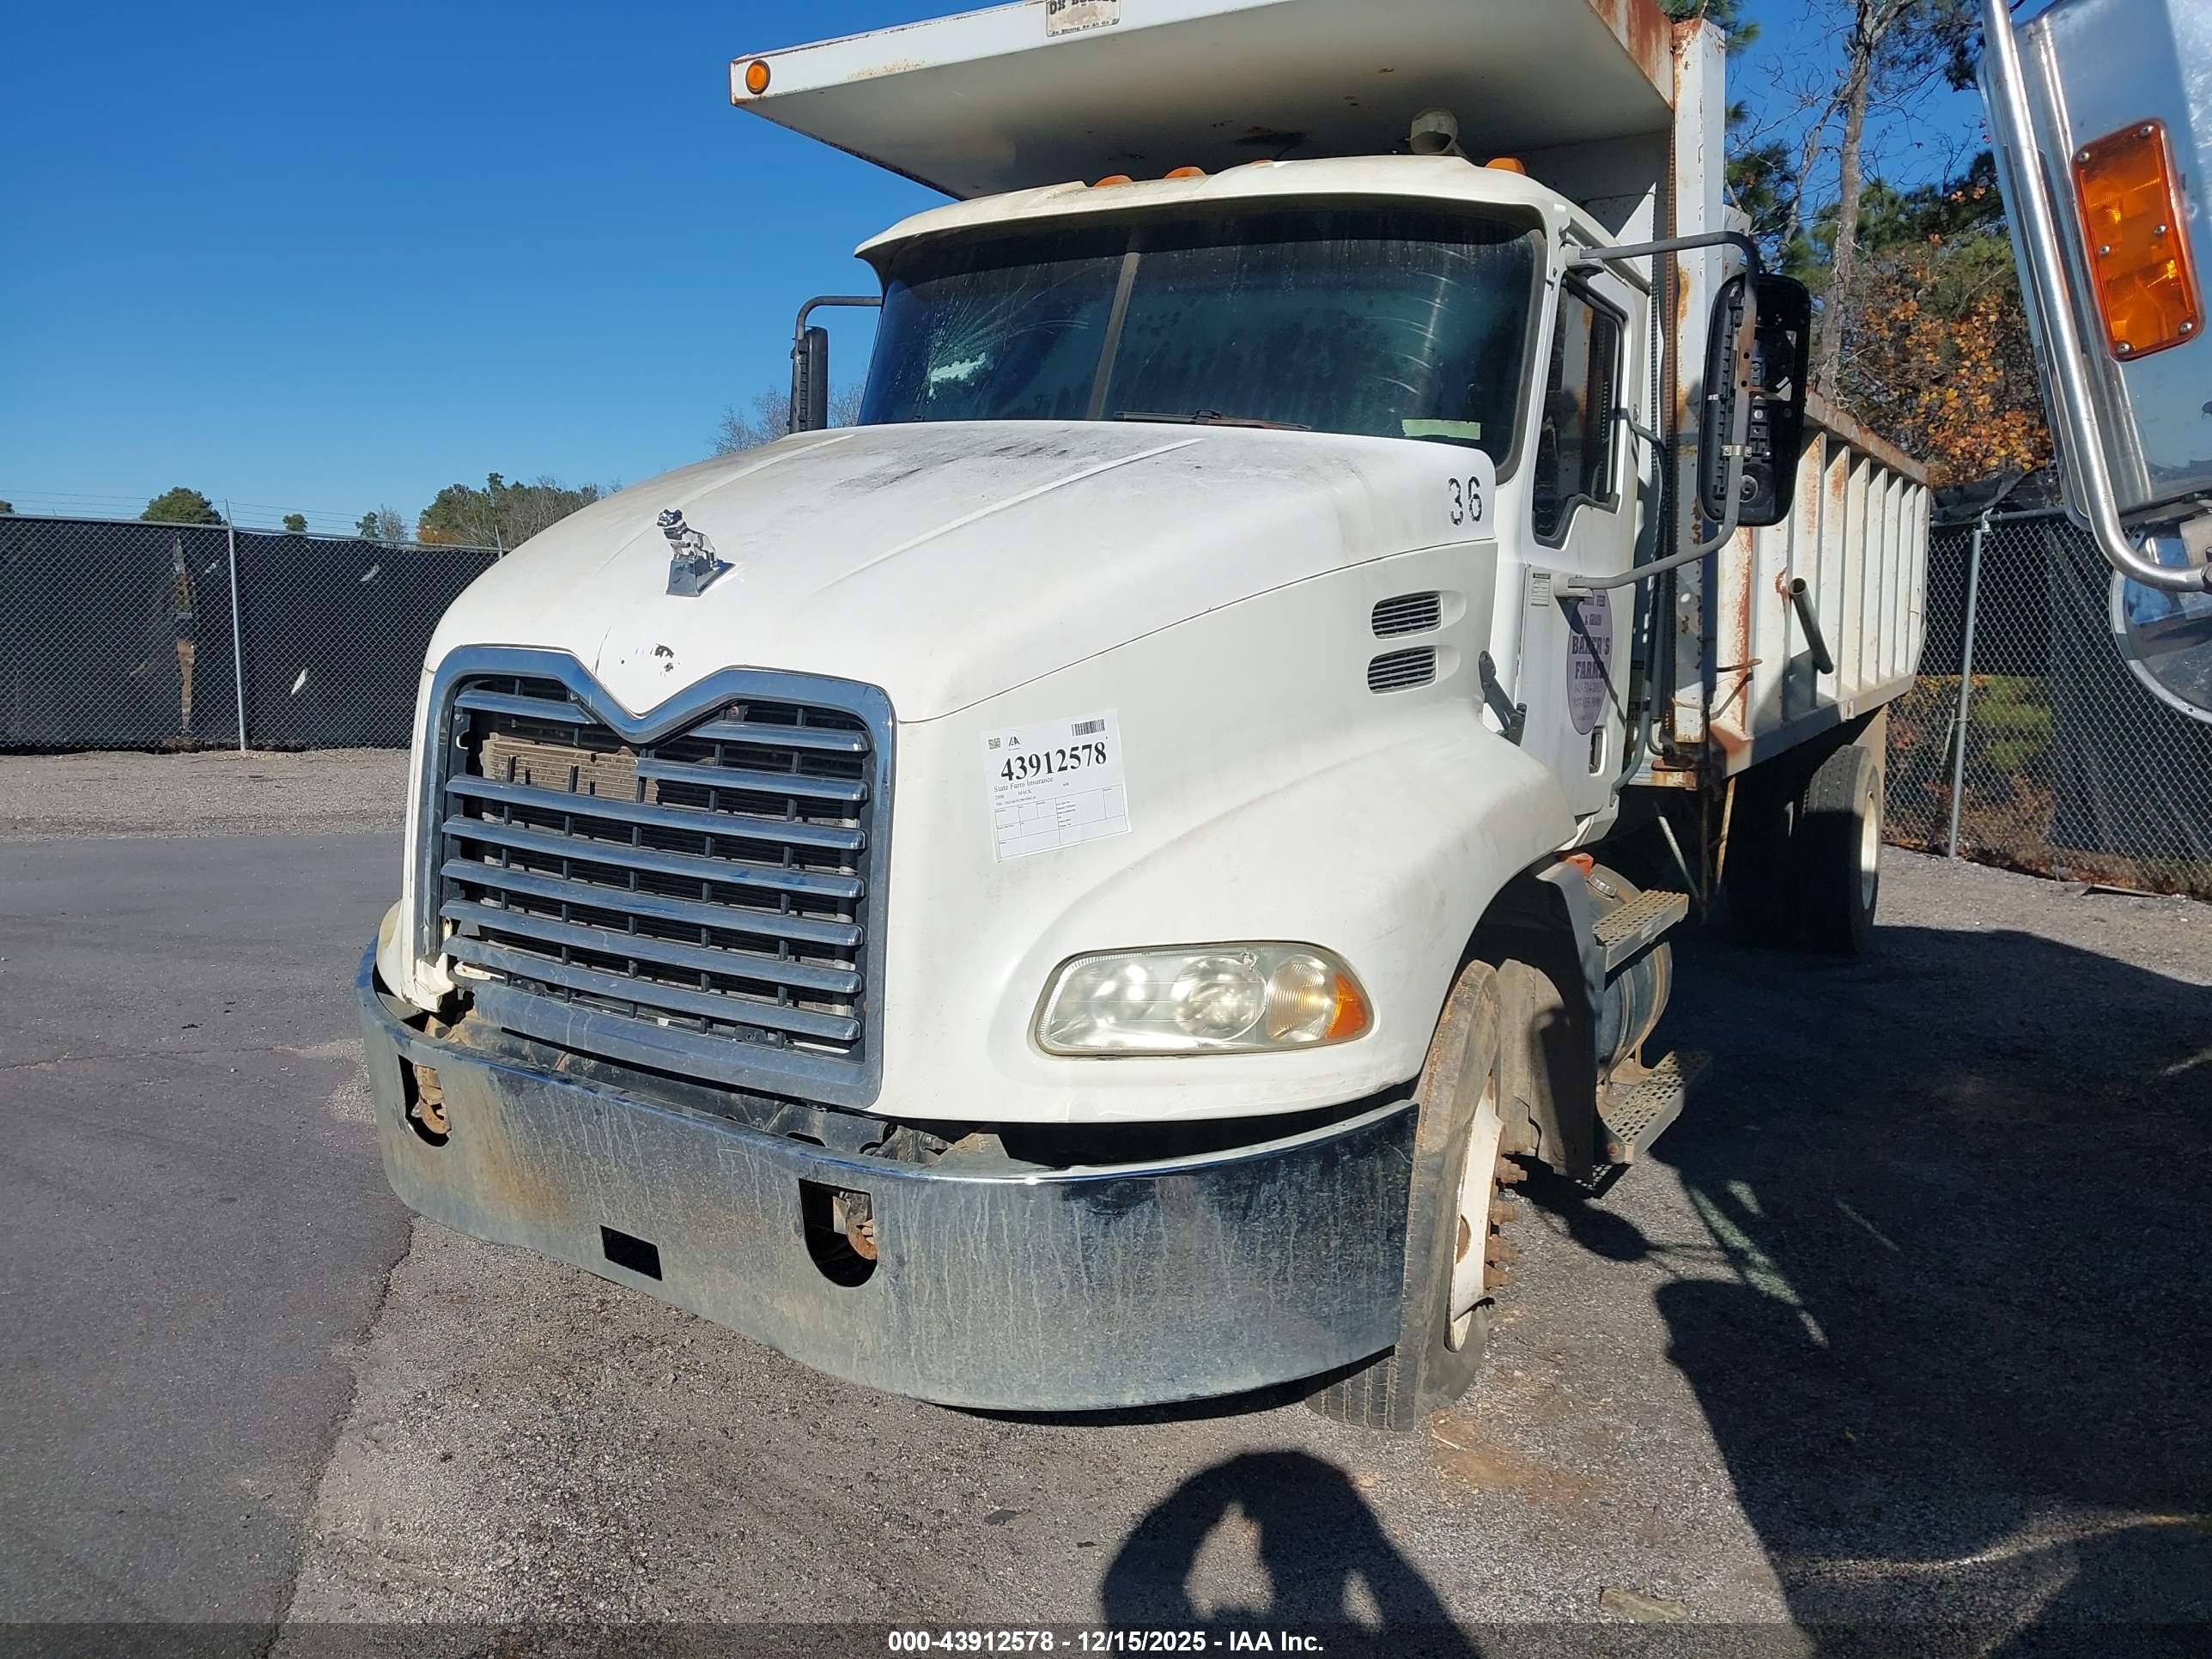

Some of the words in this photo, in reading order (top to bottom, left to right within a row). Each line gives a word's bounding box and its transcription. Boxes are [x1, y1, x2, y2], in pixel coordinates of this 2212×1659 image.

[1448, 476, 1482, 526] 36
[1000, 741, 1107, 781] 43912578
[1026, 777, 1054, 787] Insurance
